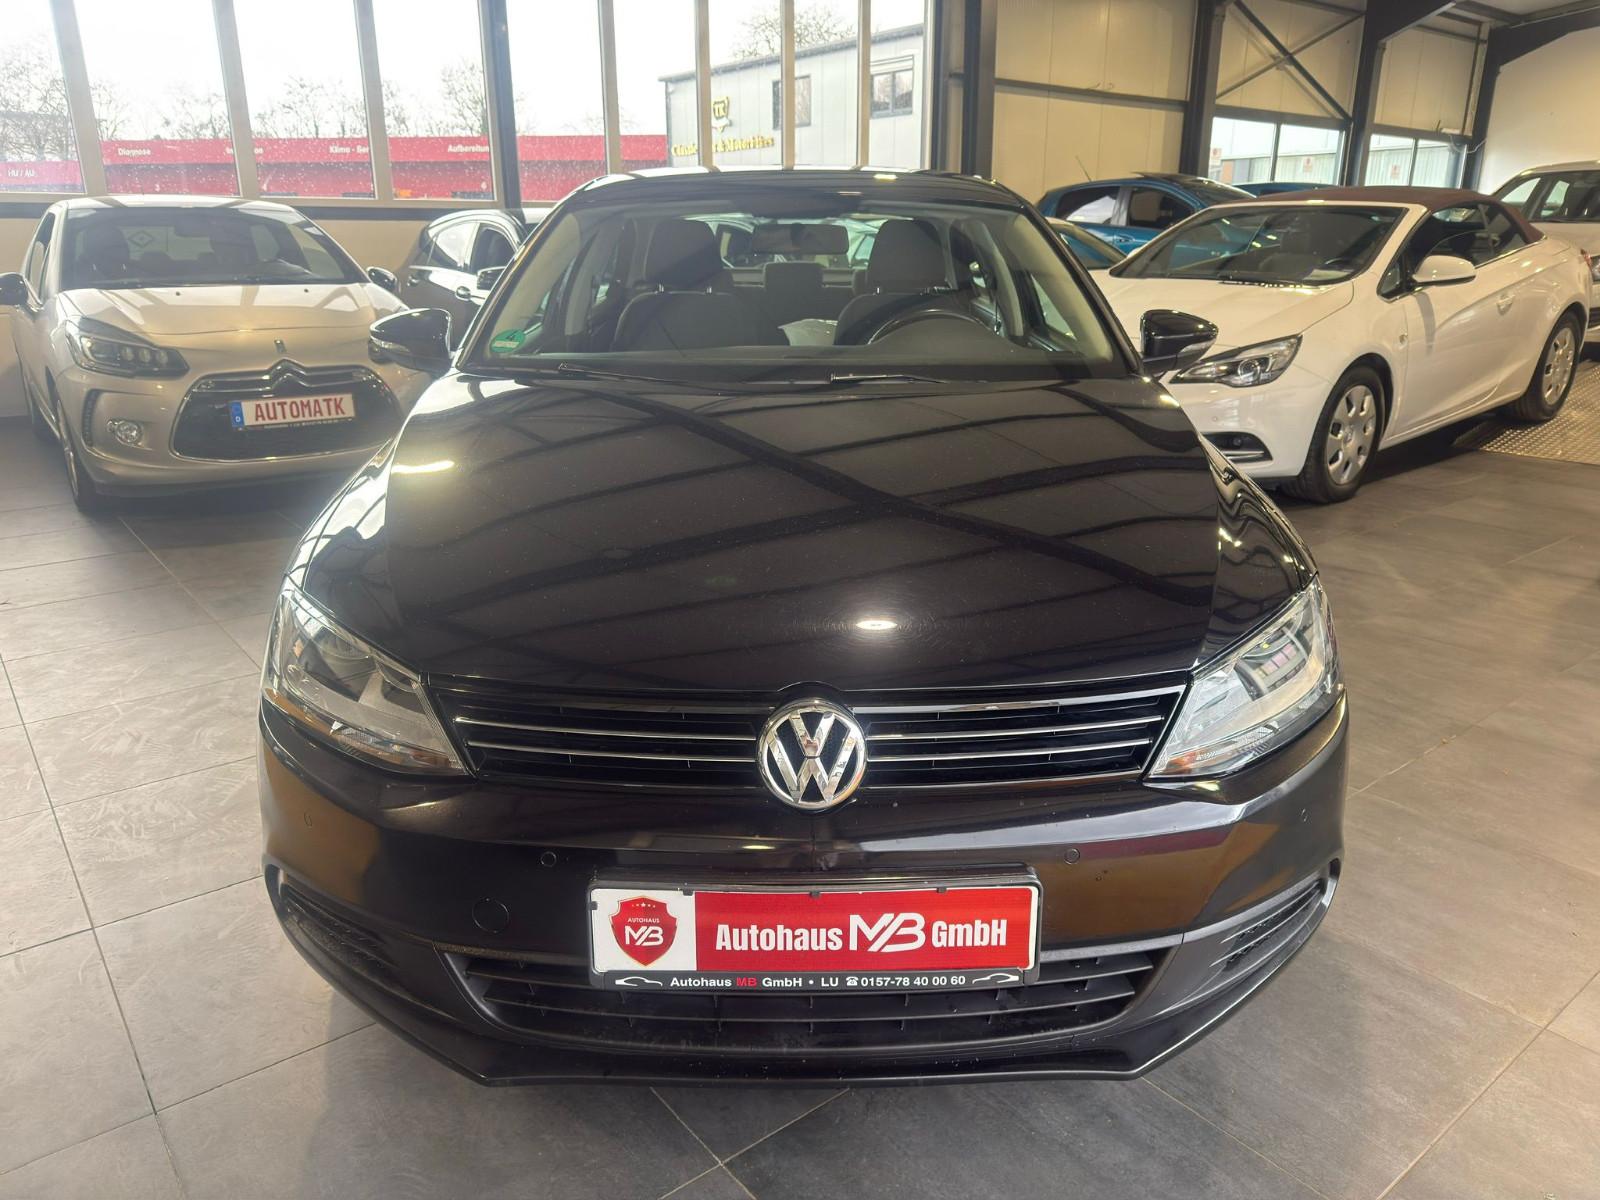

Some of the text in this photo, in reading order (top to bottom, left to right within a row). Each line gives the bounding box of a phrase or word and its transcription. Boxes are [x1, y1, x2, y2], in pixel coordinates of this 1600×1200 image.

[117, 147, 151, 157] Diagnose
[448, 144, 490, 153] Aufbereitun
[254, 397, 346, 422] AUTOMATK
[624, 925, 664, 946] MB
[715, 912, 1007, 952] Autohaus MB GmbH
[670, 974, 966, 988] Autohaus MB GmbH LU 0157-78 40 00 60
